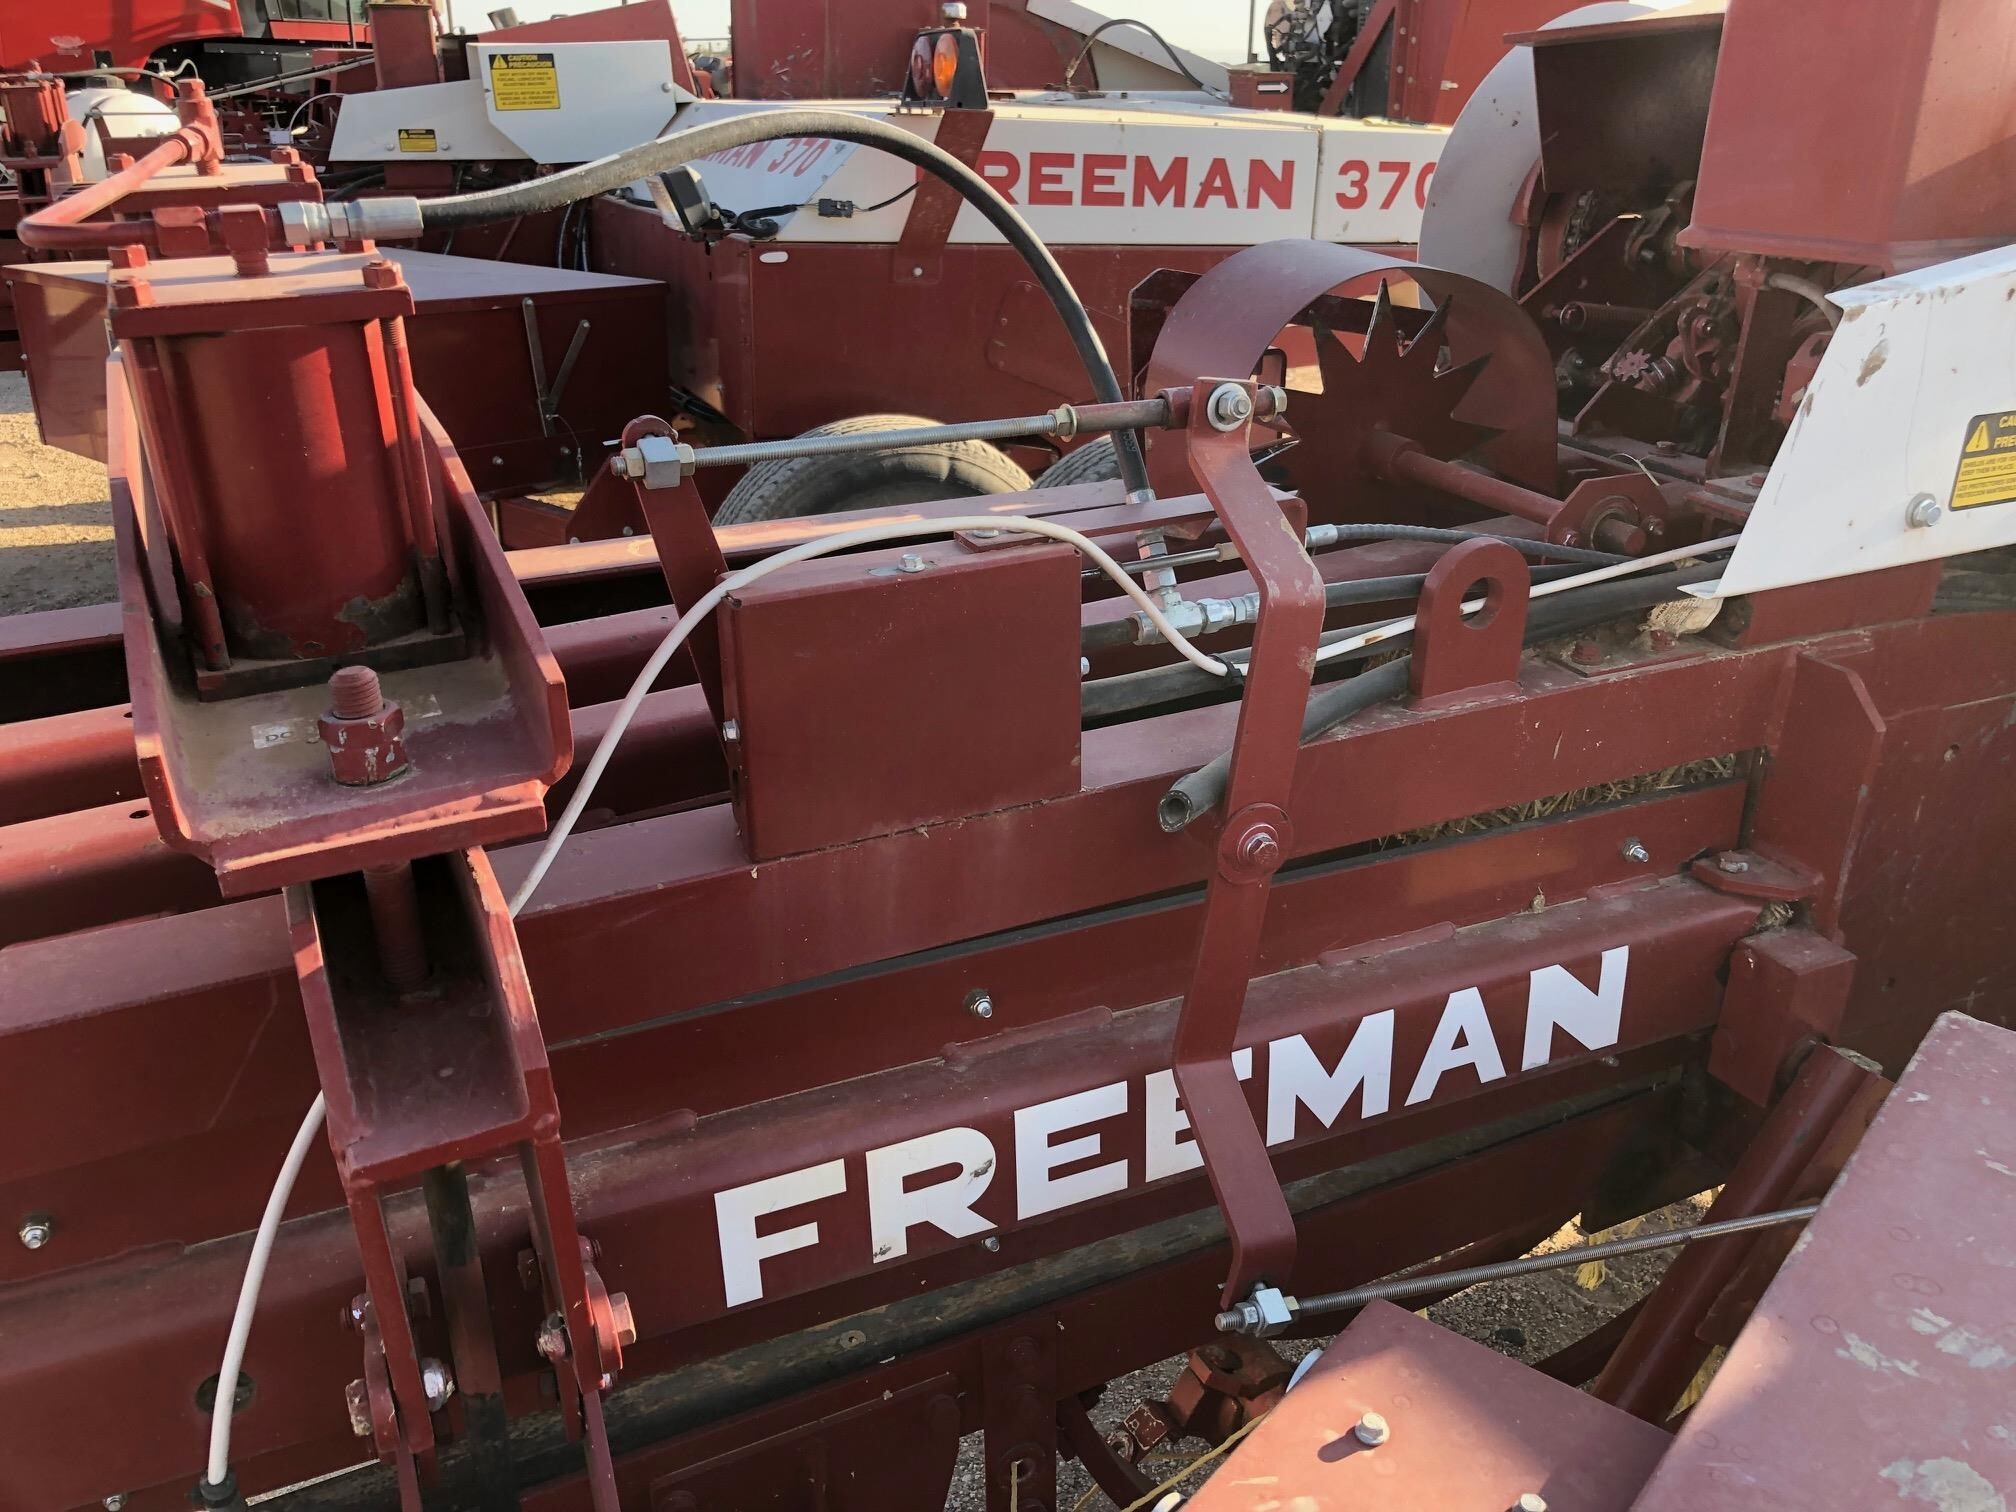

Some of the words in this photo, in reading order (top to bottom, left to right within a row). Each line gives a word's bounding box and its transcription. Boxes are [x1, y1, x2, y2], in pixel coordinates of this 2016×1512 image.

[768, 137, 832, 178] 370
[916, 150, 1295, 210] REEMAN
[714, 945, 1630, 1308] FREEMAN
